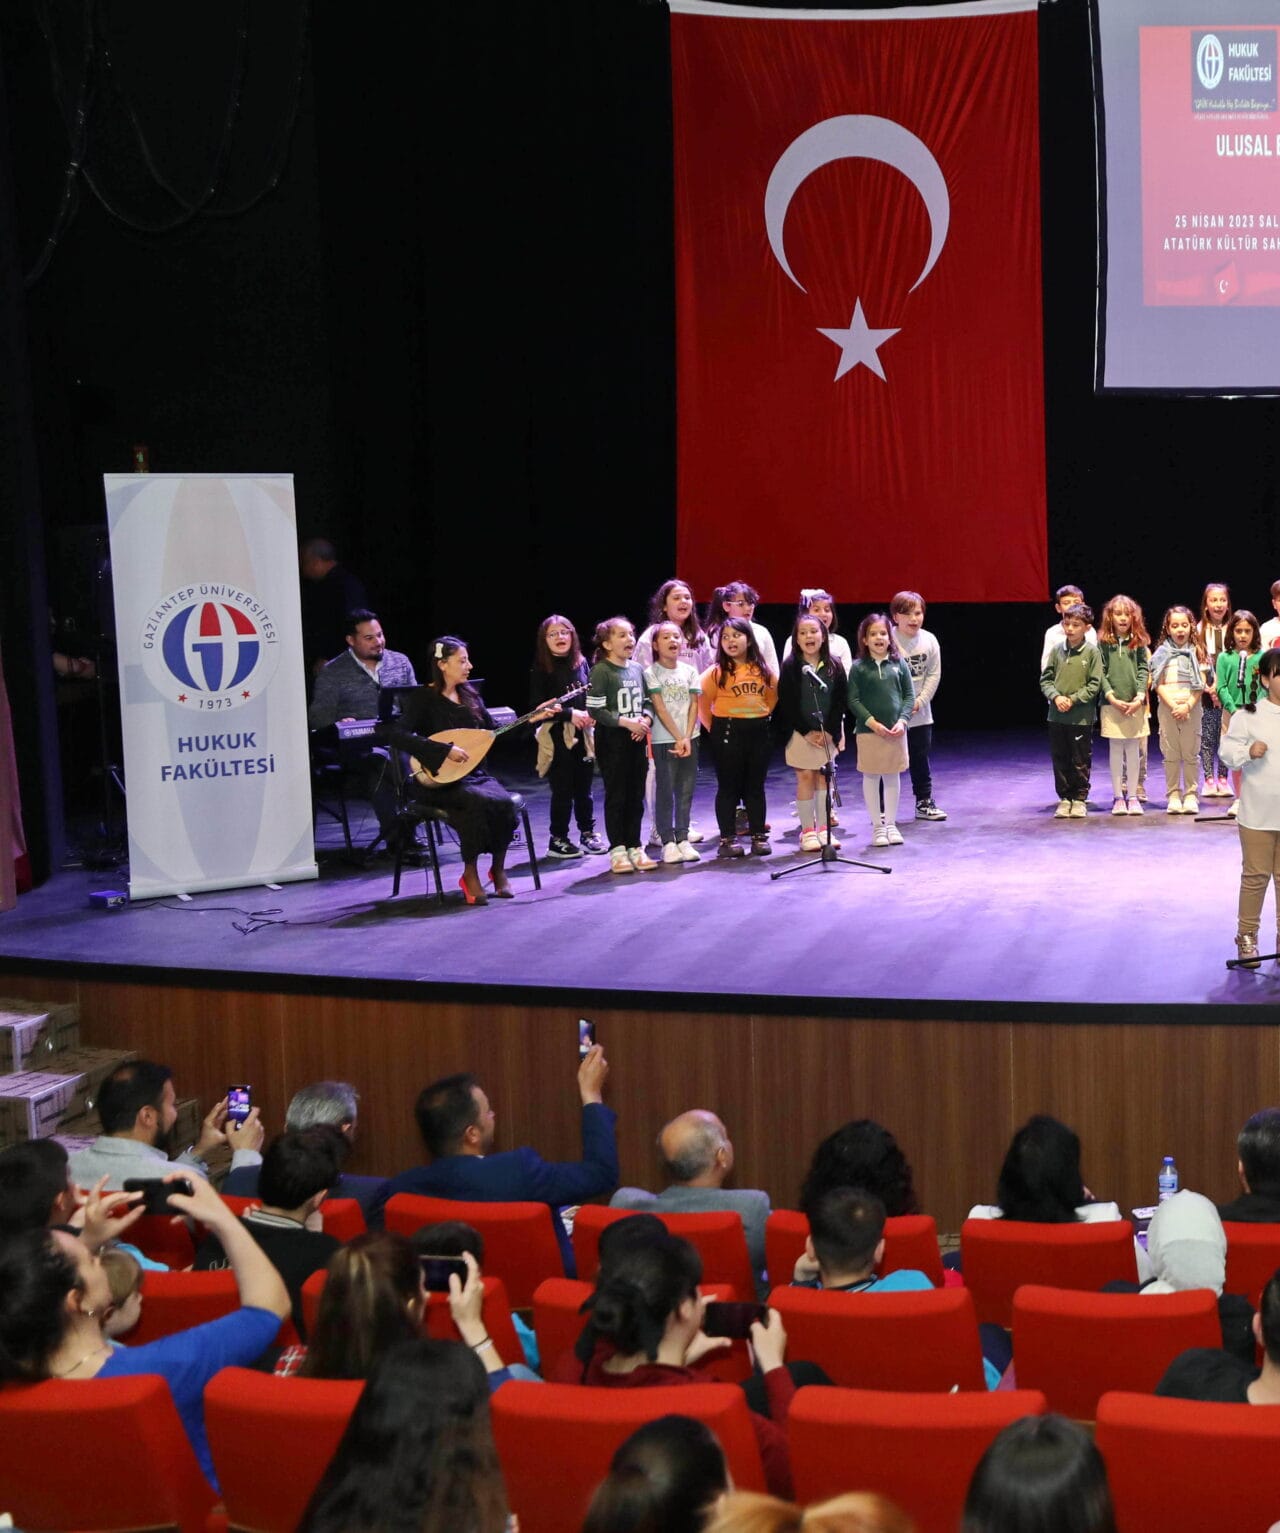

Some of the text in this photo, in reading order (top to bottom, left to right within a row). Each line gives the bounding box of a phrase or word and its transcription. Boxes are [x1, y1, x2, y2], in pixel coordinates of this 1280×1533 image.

[1228, 42, 1259, 57] HUKUK
[1228, 64, 1272, 81] FAKÜLTESİ
[1216, 134, 1273, 156] ULUSAL
[1175, 214, 1188, 228] 25
[1192, 212, 1224, 228] NİSAN
[1229, 215, 1254, 228] 2023
[1163, 234, 1212, 251] ATATÜRK
[1217, 234, 1258, 251] KÜLTÜR
[143, 584, 278, 649] GAZİANTEP ÜNİVERSİTESİ
[199, 697, 232, 710] 1973
[617, 687, 643, 714] 02
[177, 732, 257, 753] HUKUK
[160, 754, 275, 782] FAKÜLTESİ
